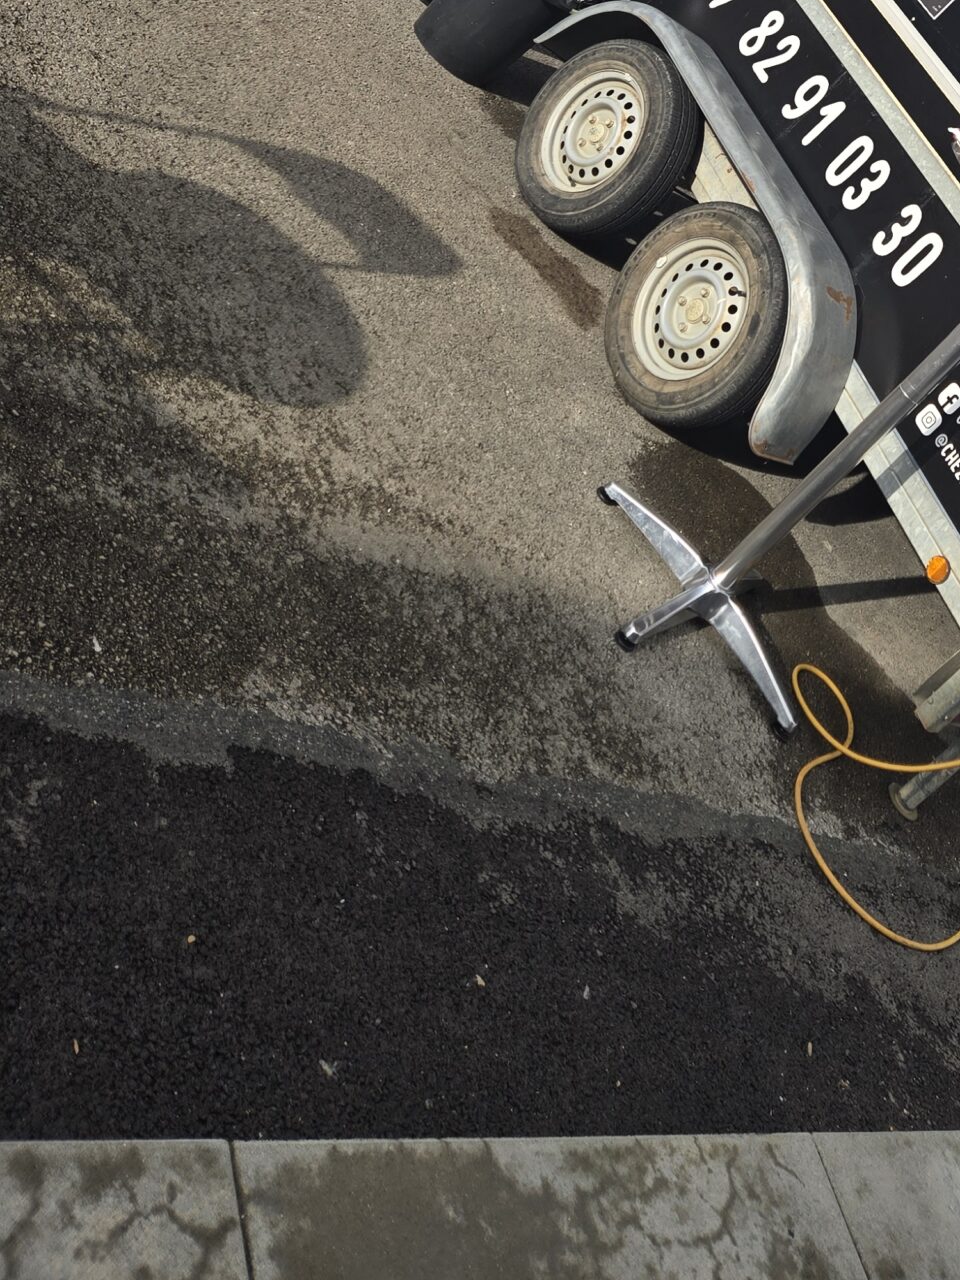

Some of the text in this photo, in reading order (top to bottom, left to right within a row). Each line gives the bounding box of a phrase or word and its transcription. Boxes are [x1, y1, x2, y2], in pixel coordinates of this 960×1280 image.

[739, 10, 801, 83] 82
[782, 74, 847, 146] 91
[825, 135, 891, 210] 03
[871, 204, 944, 287] 30
